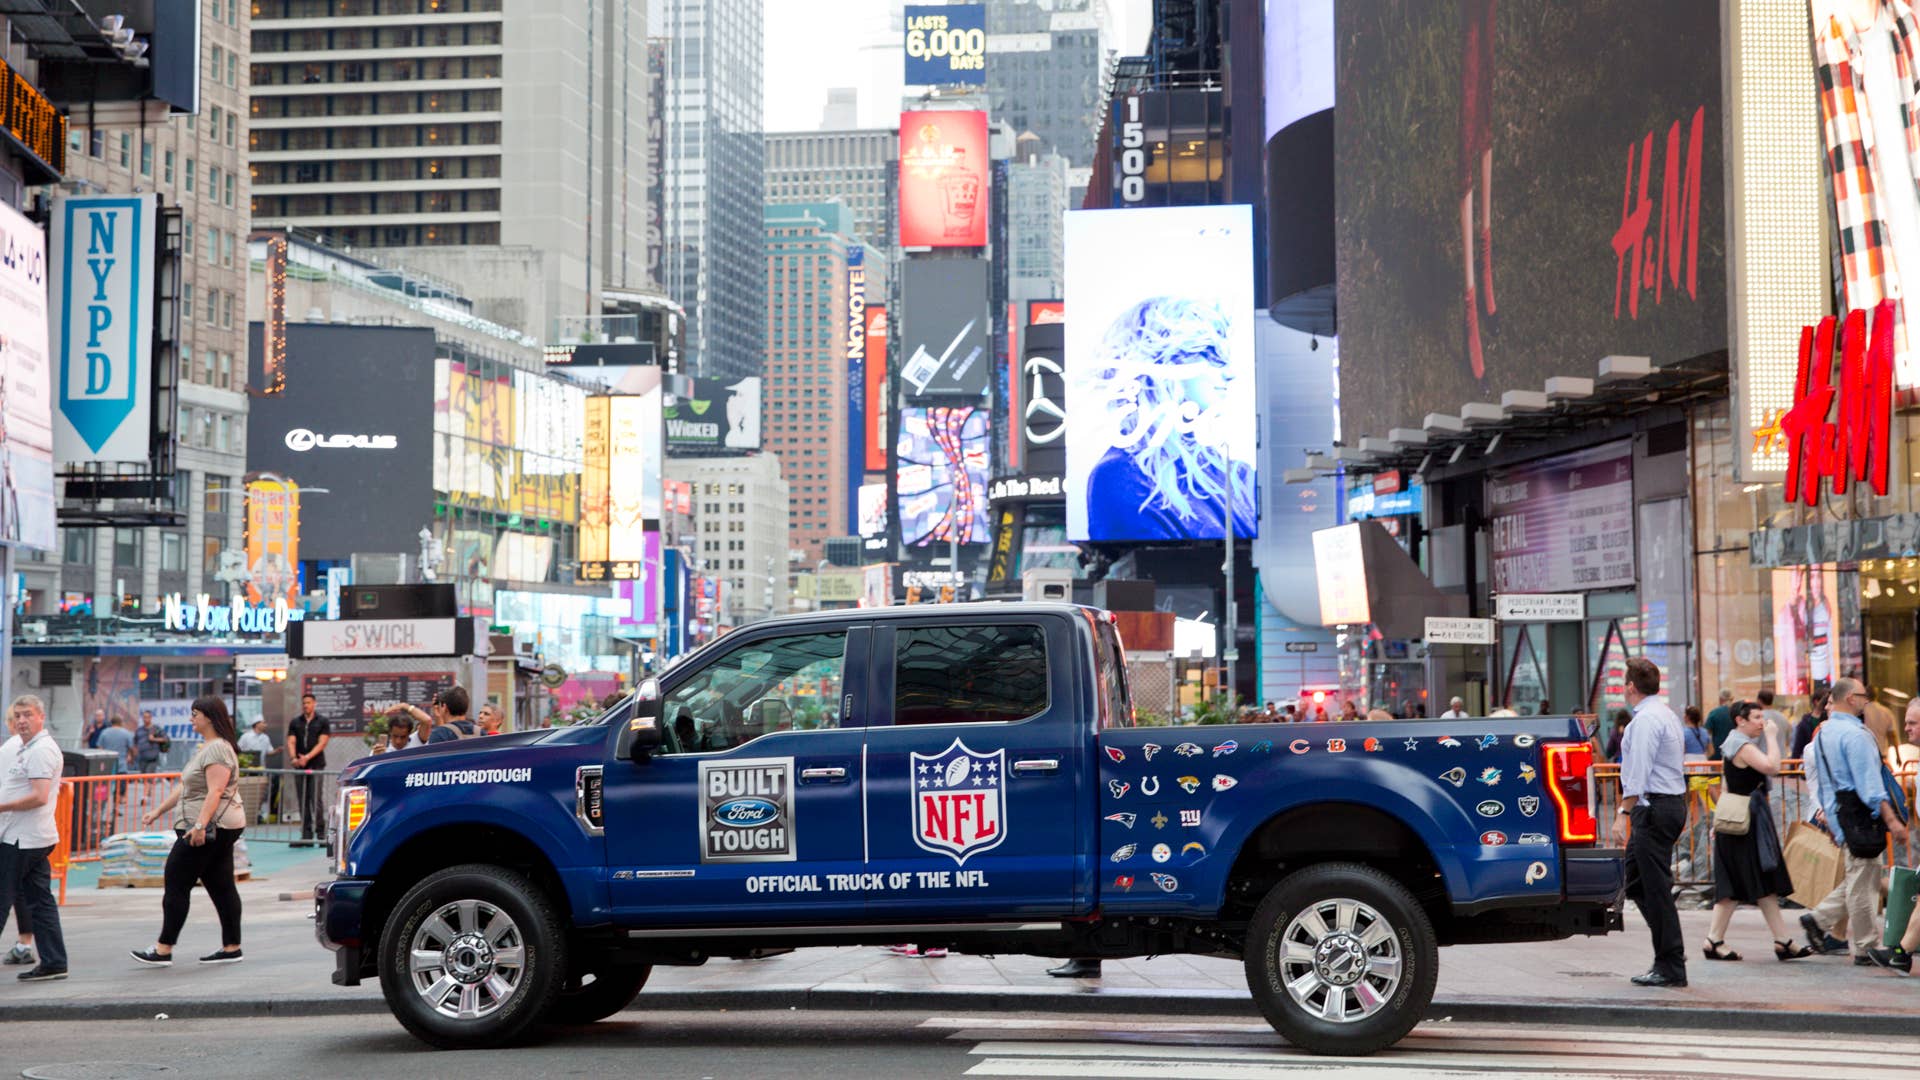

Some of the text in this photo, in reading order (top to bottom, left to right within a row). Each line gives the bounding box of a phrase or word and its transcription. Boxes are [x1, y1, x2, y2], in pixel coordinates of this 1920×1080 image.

[907, 15, 948, 30] LASTS
[906, 28, 985, 62] 6,000
[950, 55, 985, 70] DAYS
[1122, 96, 1145, 202] 1500
[1611, 105, 1705, 320] H&M
[85, 211, 118, 395] NYPD
[847, 265, 865, 359] NOVOTEL
[1780, 297, 1897, 507] H&M
[316, 433, 398, 449] LEXUS
[405, 768, 532, 788] #BUILTFORDTOUGH
[709, 768, 784, 797] BUILT
[727, 803, 765, 820] Ford
[923, 793, 995, 846] NFL
[710, 828, 785, 851] TOUGH
[746, 870, 989, 893] OFFICIAL TRUCK OF THE NFL
